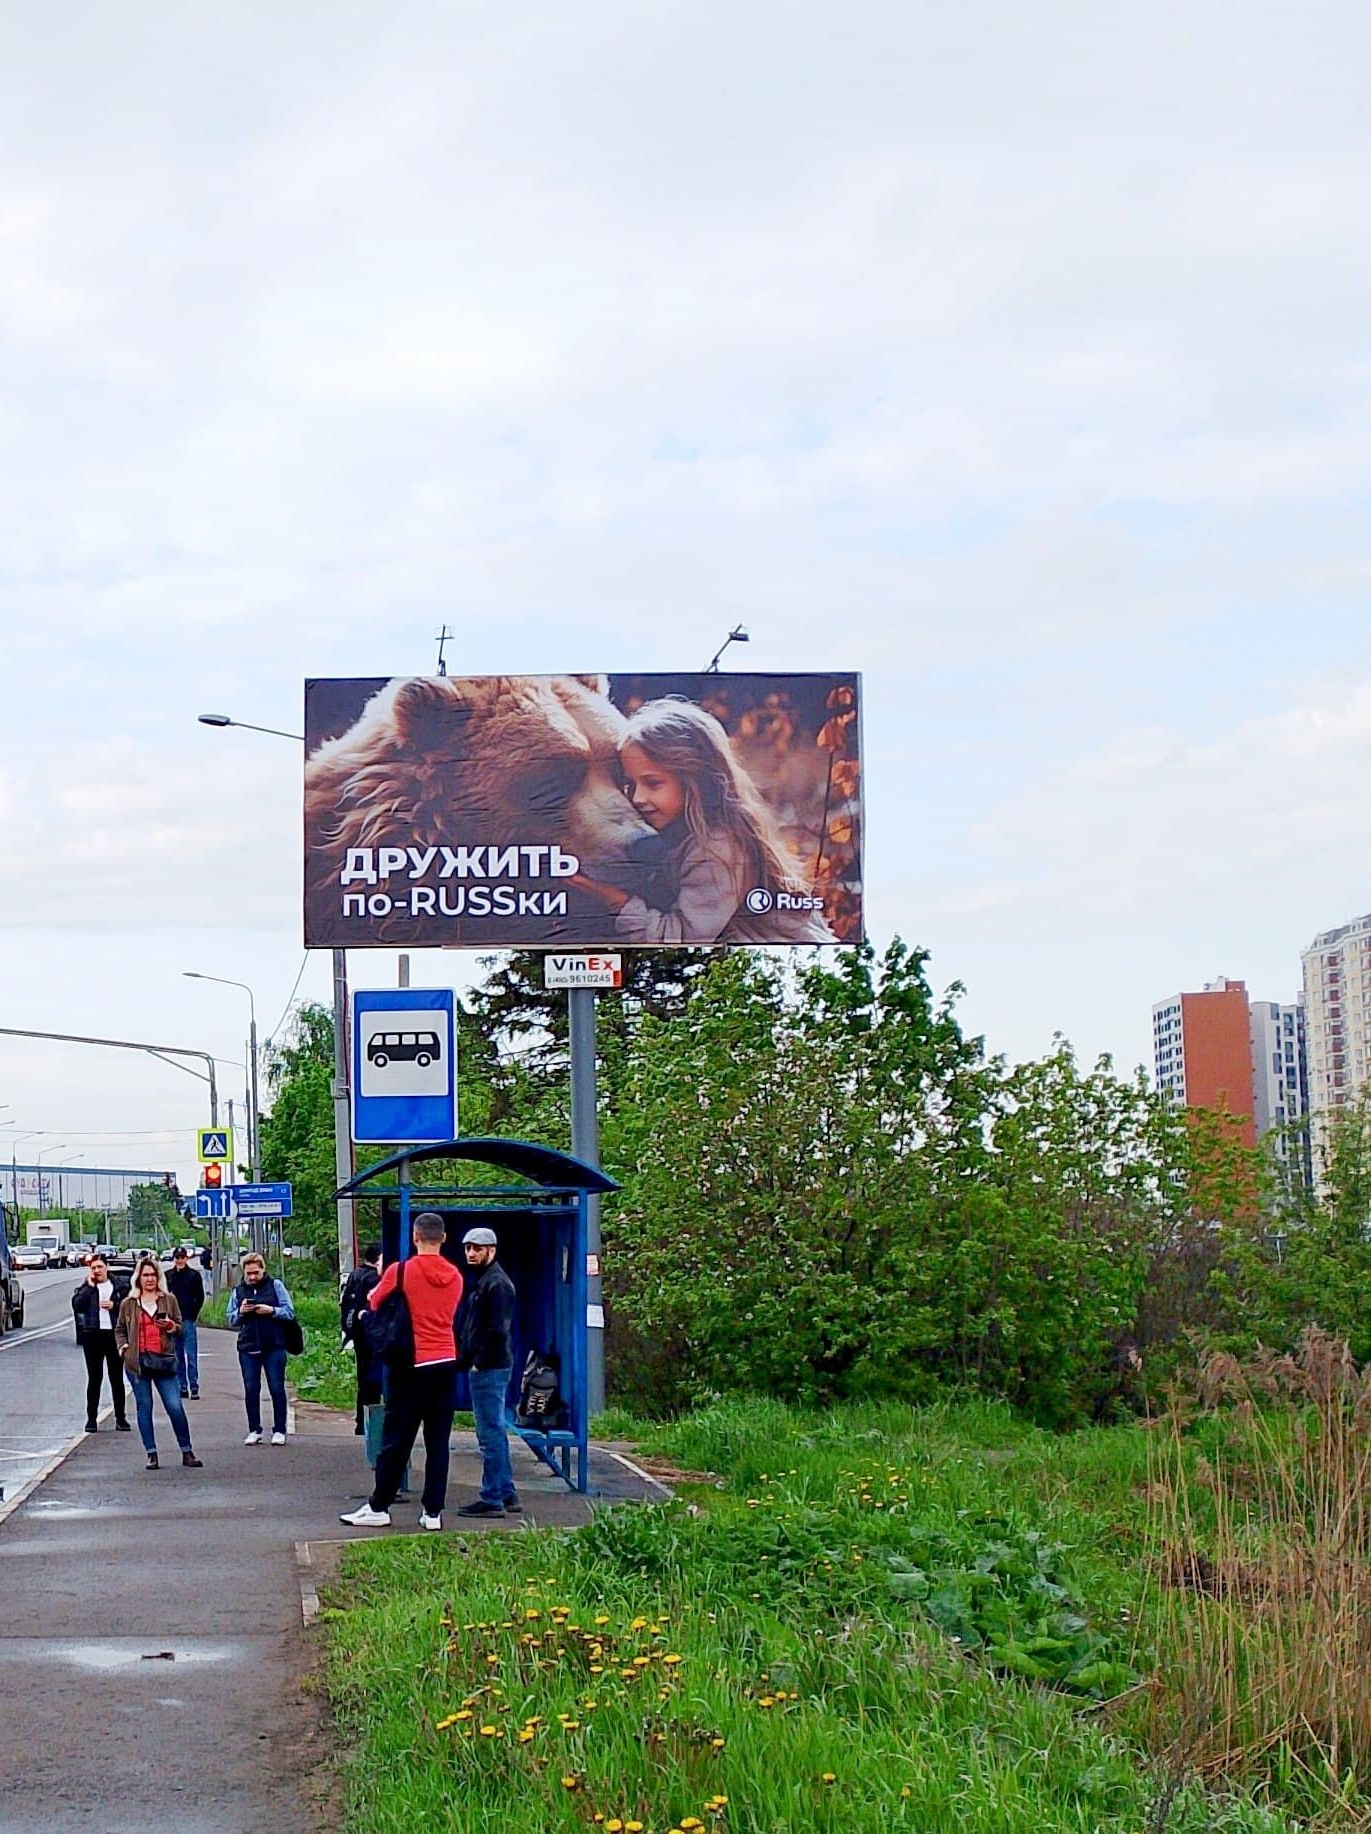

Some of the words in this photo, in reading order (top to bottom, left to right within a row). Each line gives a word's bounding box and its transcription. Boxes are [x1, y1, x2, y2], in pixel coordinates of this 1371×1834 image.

[340, 846, 580, 885] ДРУЖИТЬ
[343, 886, 568, 917] по-RUSSки
[777, 893, 824, 910] Russ
[552, 957, 613, 971] VinEx
